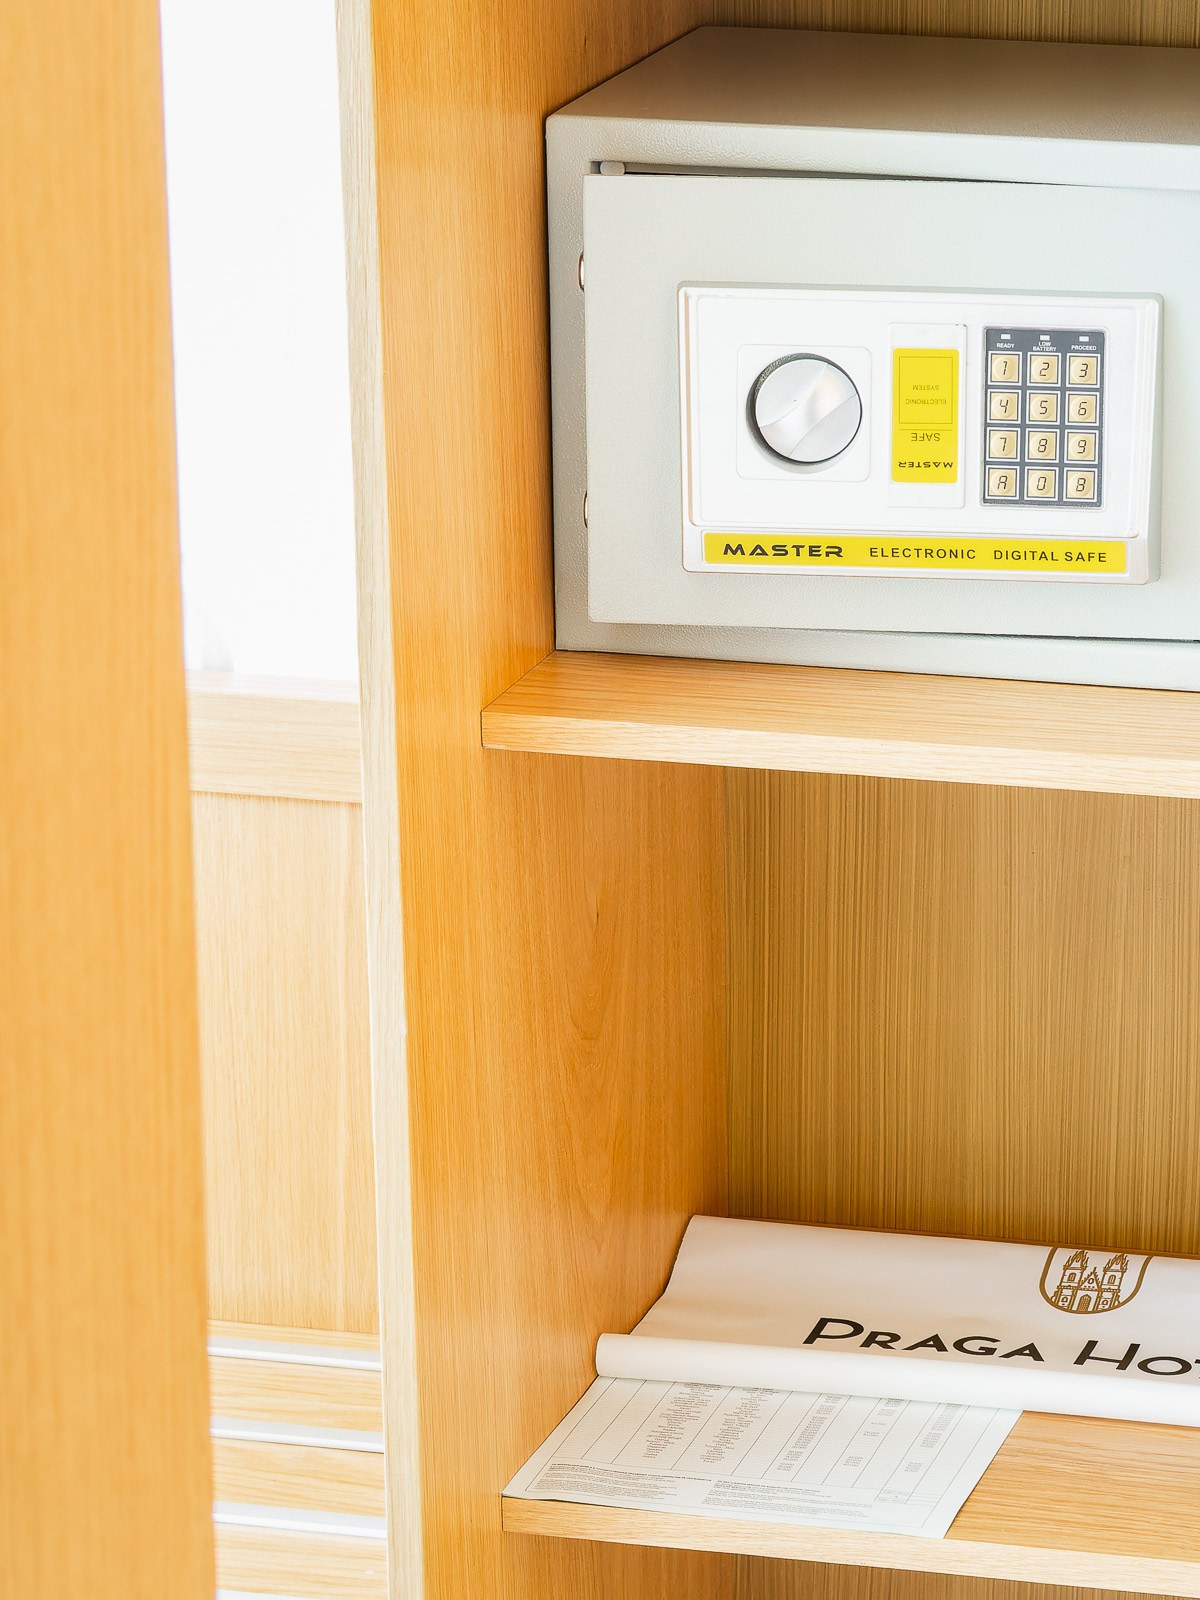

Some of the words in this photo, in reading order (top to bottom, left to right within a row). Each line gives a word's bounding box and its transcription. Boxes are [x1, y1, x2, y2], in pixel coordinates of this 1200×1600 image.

[1003, 361, 1008, 375] 1
[1039, 362, 1050, 377] 2
[1078, 363, 1089, 378] 3
[999, 399, 1009, 414] 4
[1039, 400, 1049, 415] 5
[1077, 401, 1088, 416] 6
[911, 432, 941, 442] SAFE
[999, 437, 1007, 452] 7
[1037, 438, 1048, 453] 8
[1077, 439, 1087, 454] 9
[997, 475, 1008, 490] A
[723, 543, 843, 558] MASTER
[869, 547, 977, 560] ELECTRONIC
[994, 549, 1059, 562] DIGITAL
[1064, 551, 1107, 563] SAFE
[802, 1317, 1045, 1362] PRAGA
